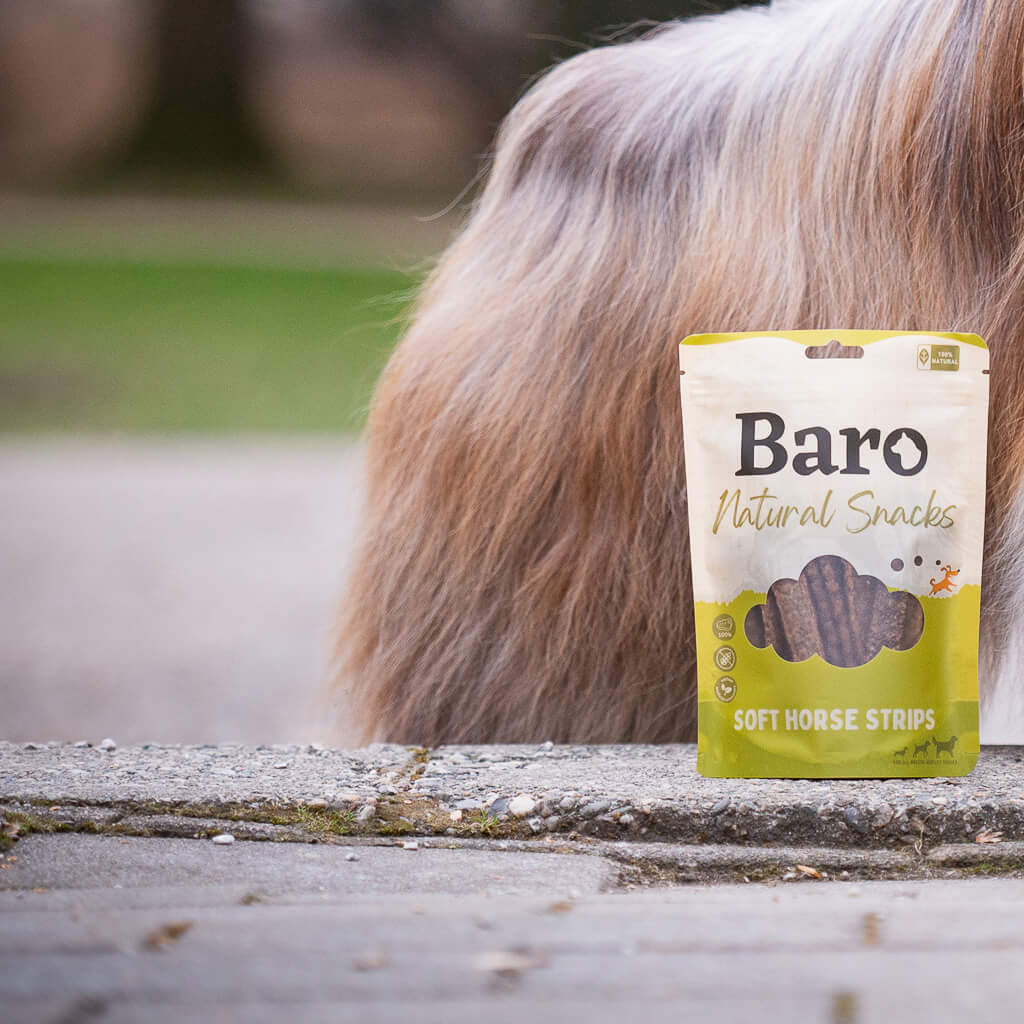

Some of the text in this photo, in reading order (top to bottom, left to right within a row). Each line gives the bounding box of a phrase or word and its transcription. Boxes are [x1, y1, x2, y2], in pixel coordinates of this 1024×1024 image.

[735, 412, 928, 476] Baro
[712, 487, 957, 535] Natural Snacks
[734, 709, 935, 730] SOFT HORSE STRIPS
